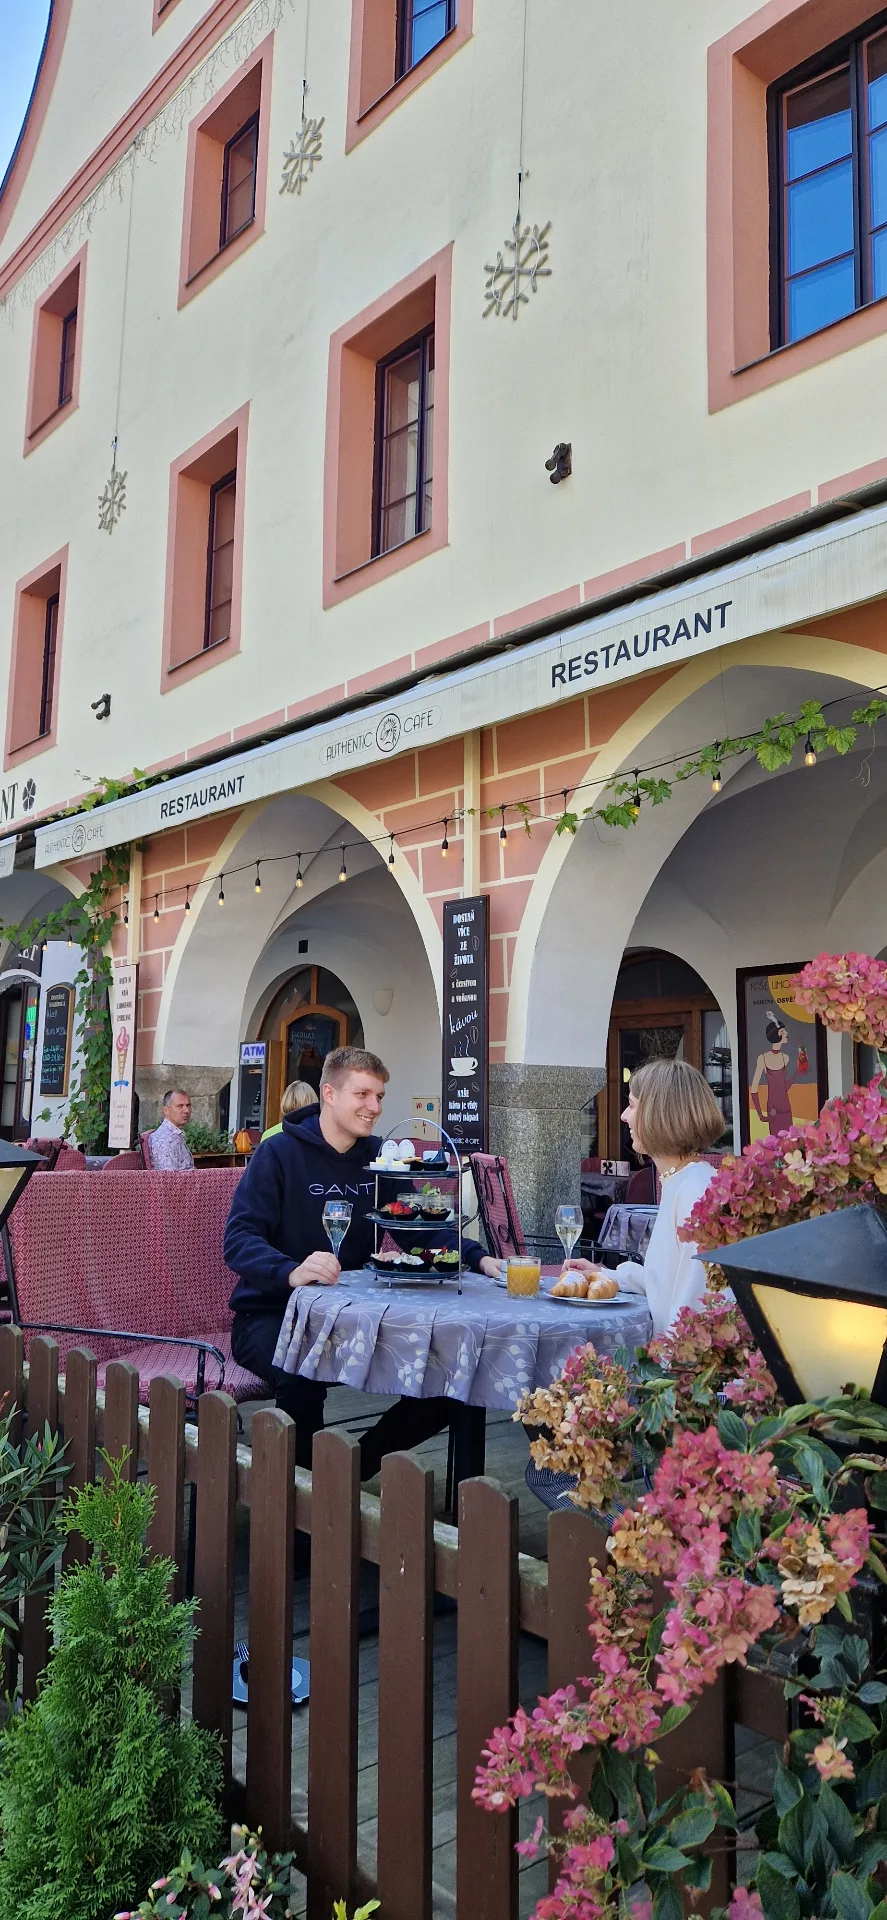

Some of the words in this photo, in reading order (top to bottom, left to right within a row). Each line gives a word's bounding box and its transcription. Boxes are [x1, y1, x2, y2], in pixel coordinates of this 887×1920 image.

[551, 600, 732, 688] RESTAURANT
[326, 731, 373, 761] AUTHENTIC
[403, 709, 434, 733] CAFE
[160, 775, 245, 819] RESTAURANT
[44, 836, 71, 855] AUTHENTIC
[86, 825, 104, 841] CAFE
[452, 909, 475, 924] DOSTAŇ
[457, 925, 470, 937] VÍCE
[460, 941, 468, 951] ZE
[453, 953, 474, 966] ŽIVOTA
[449, 1010, 478, 1035] kávou
[243, 1046, 265, 1057] ATM
[308, 1182, 376, 1196] GANT
